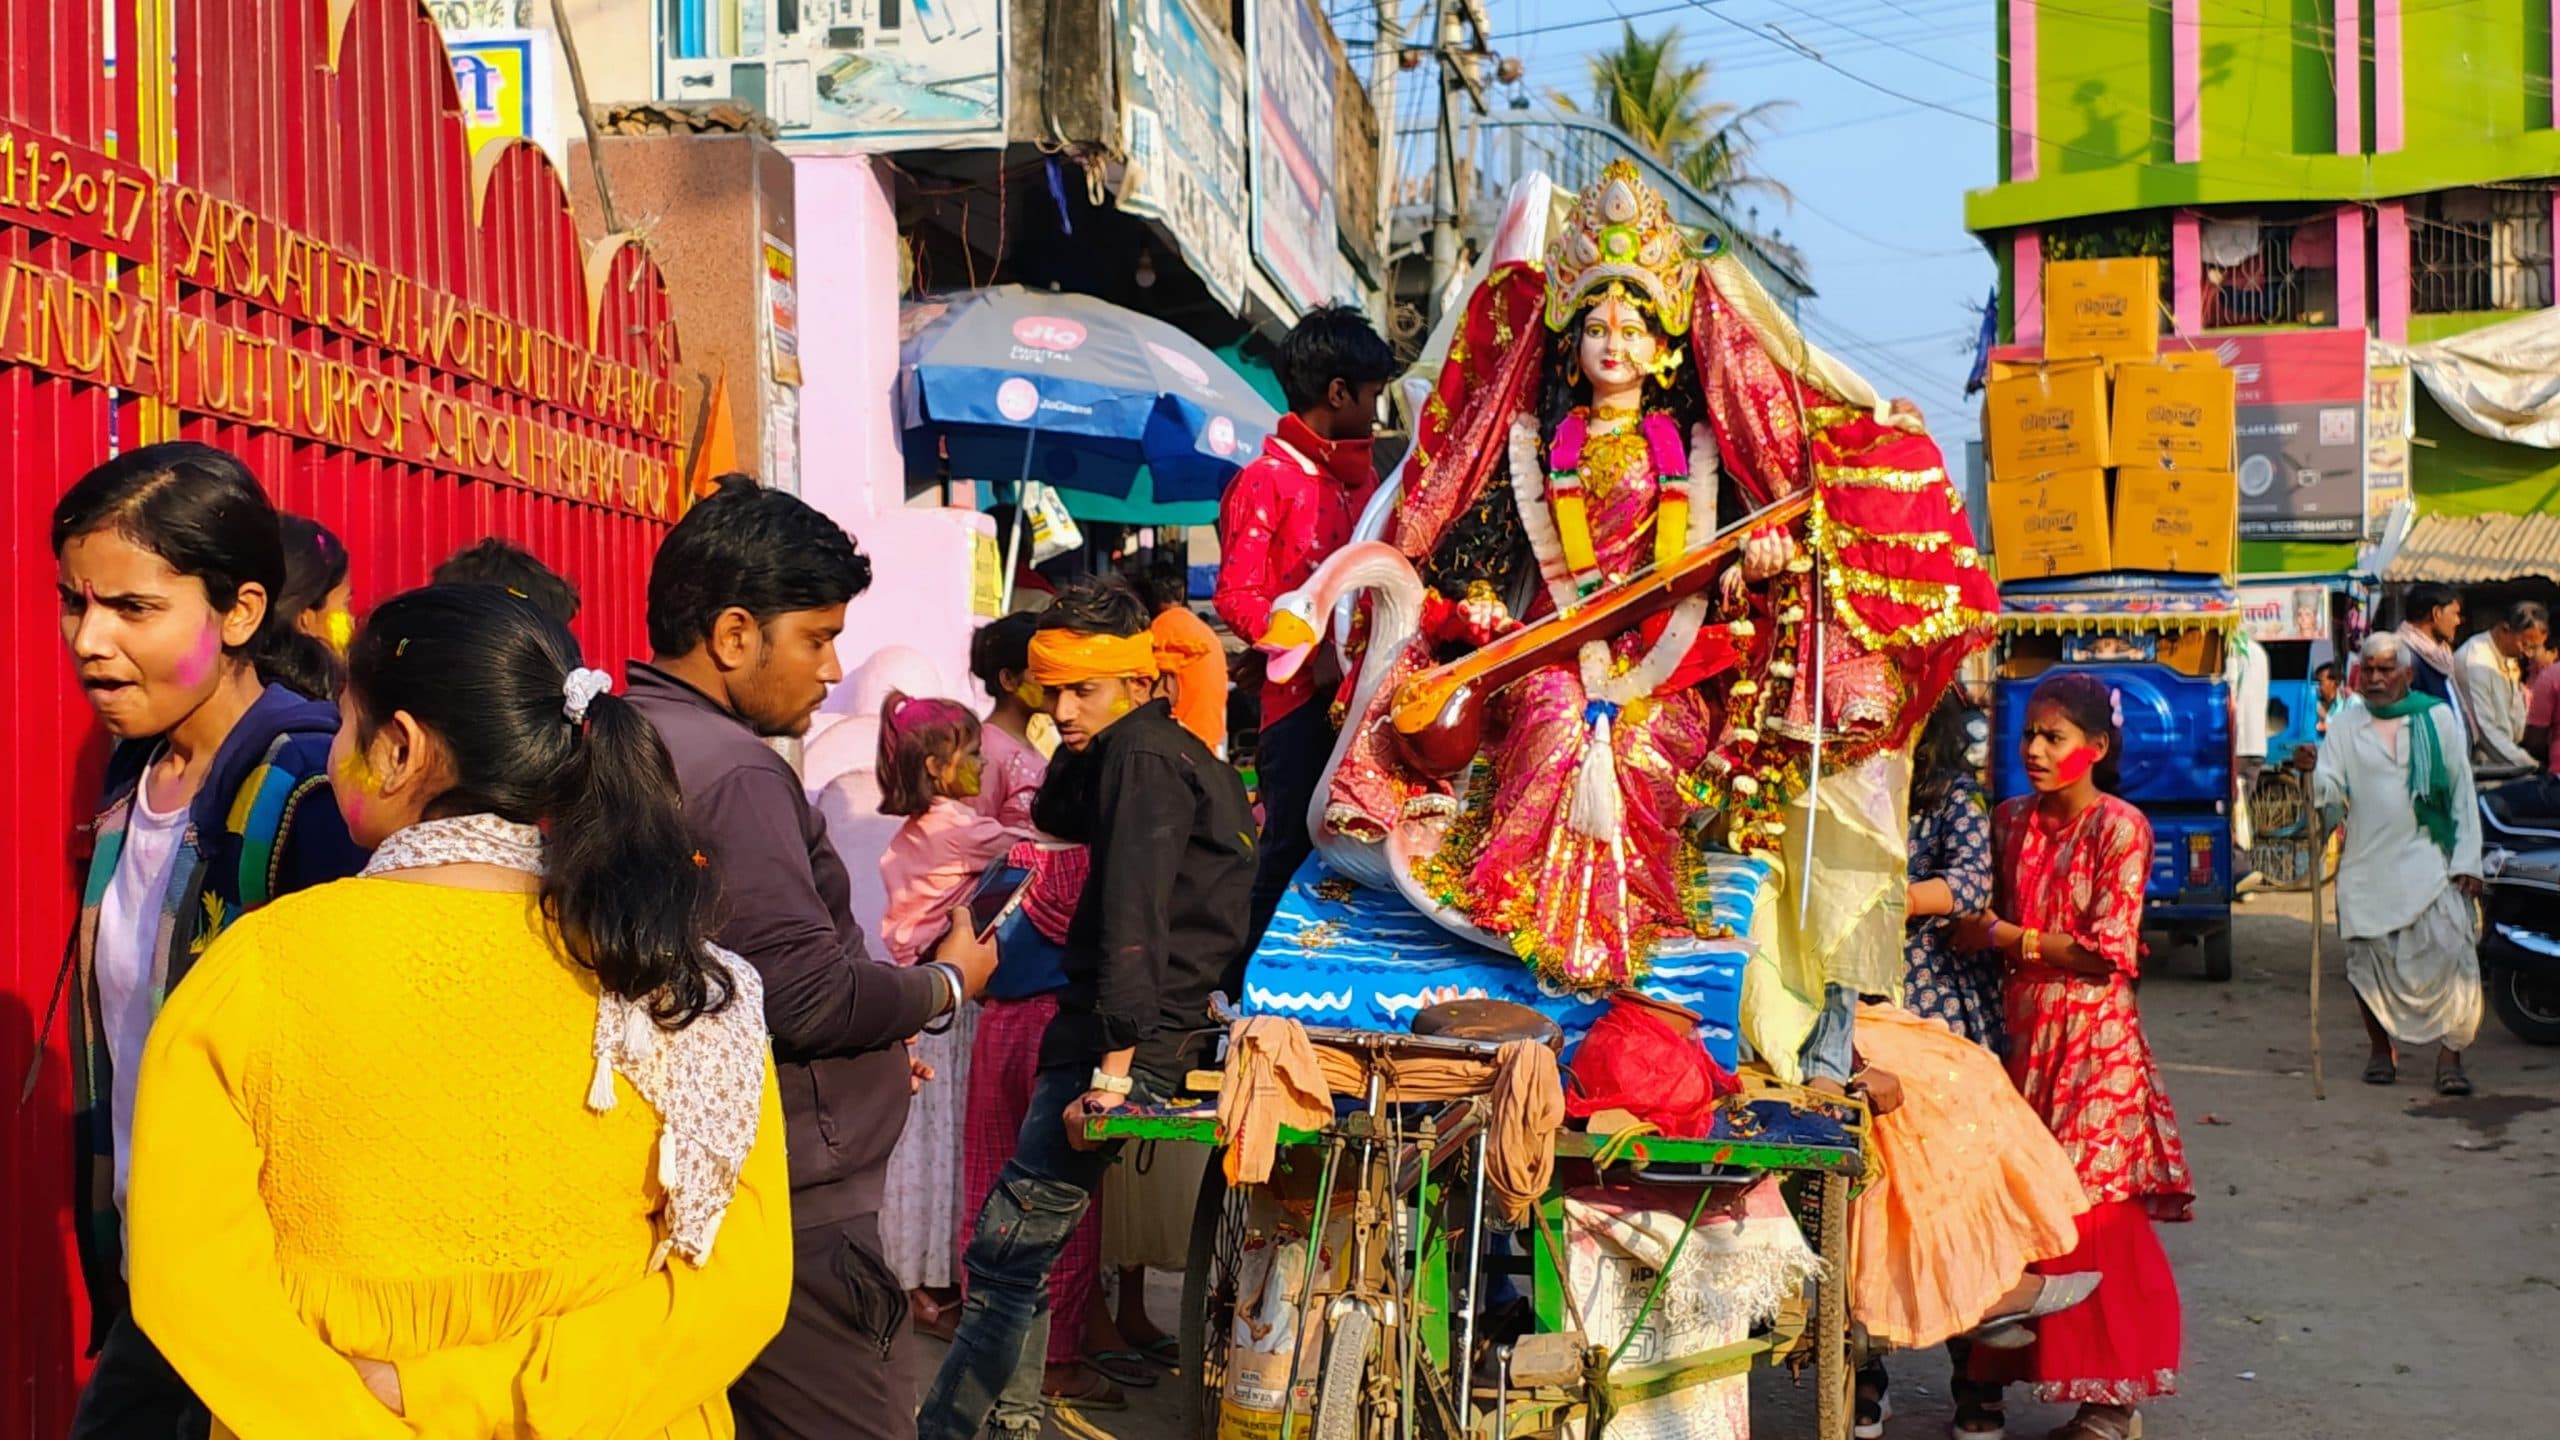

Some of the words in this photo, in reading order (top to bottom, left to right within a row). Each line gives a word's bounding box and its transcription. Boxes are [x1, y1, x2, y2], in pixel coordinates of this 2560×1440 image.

[173, 186, 330, 326] SARSWATI
[337, 256, 410, 354] DEVI
[1022, 325, 1077, 345] Jio
[167, 312, 278, 427] MULTI
[421, 387, 527, 484] SCHOOL
